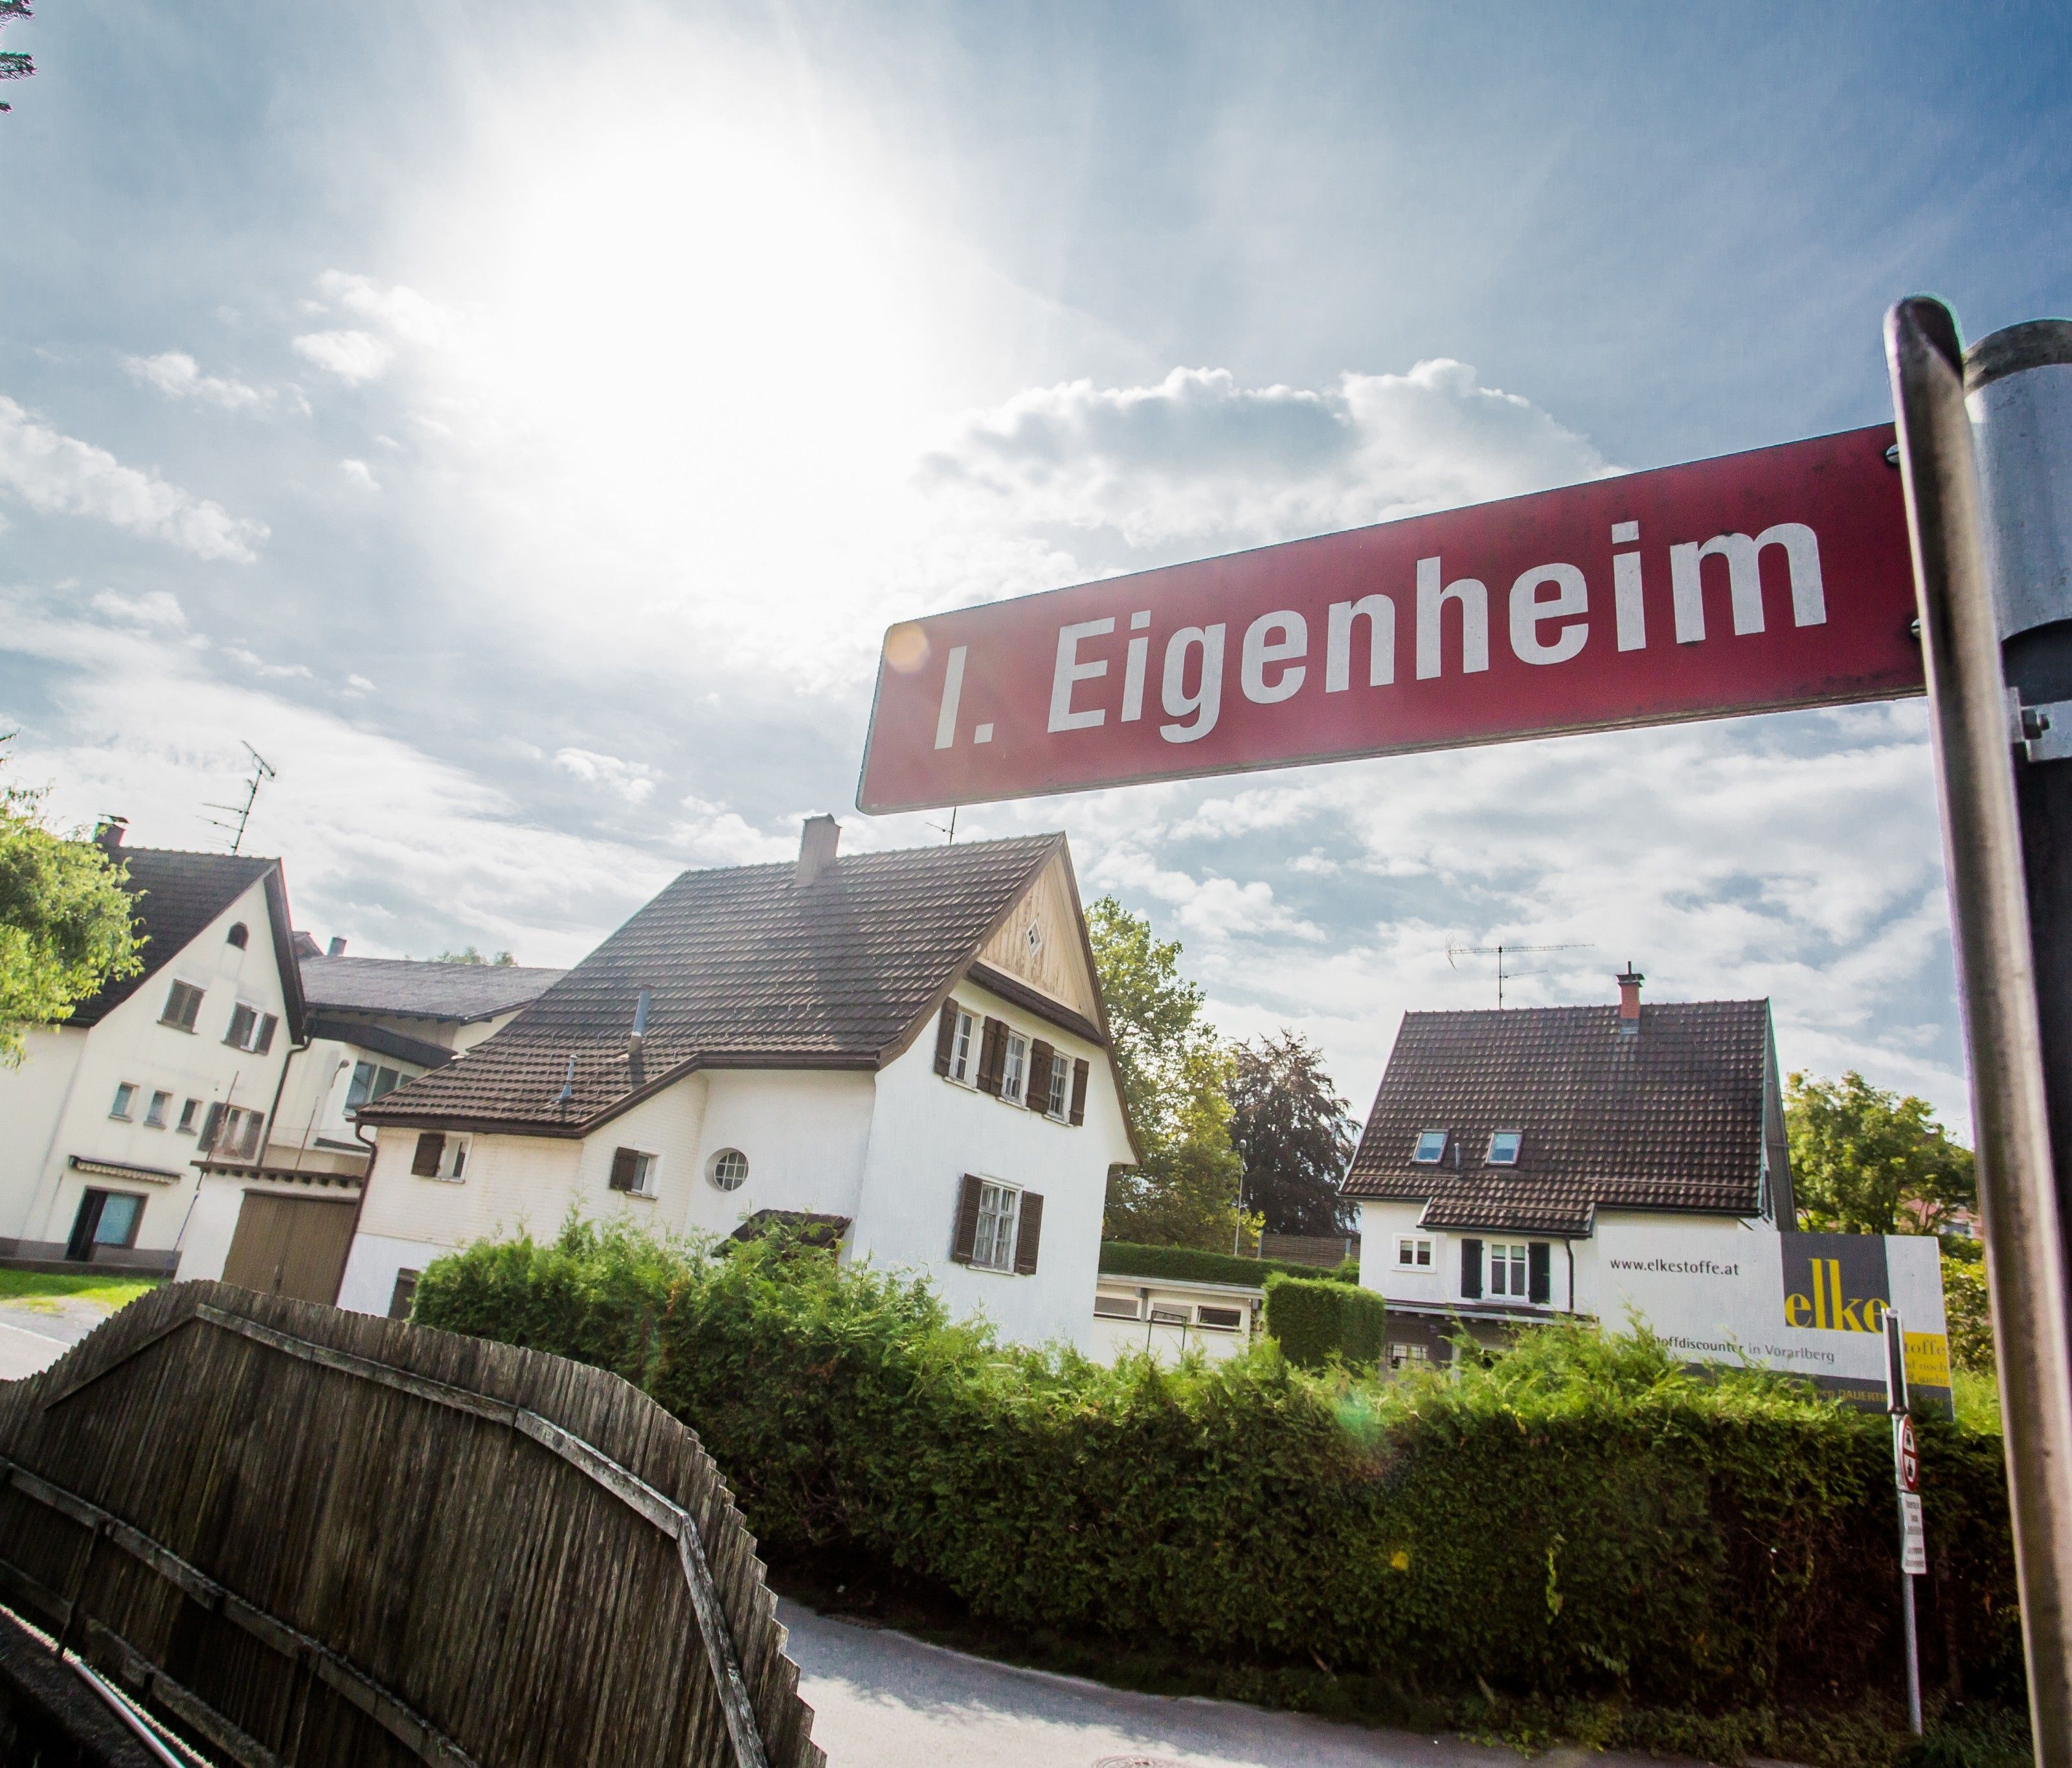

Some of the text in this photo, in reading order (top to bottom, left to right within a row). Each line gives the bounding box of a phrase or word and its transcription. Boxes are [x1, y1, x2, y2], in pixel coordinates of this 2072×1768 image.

[1046, 520, 1827, 744] Eigenheim
[1610, 1258, 1740, 1277] www.elkestoffe.at
[1785, 1257, 1889, 1334] elke
[1748, 1341, 1761, 1355] in
[1764, 1344, 1836, 1365] Vorarlberg
